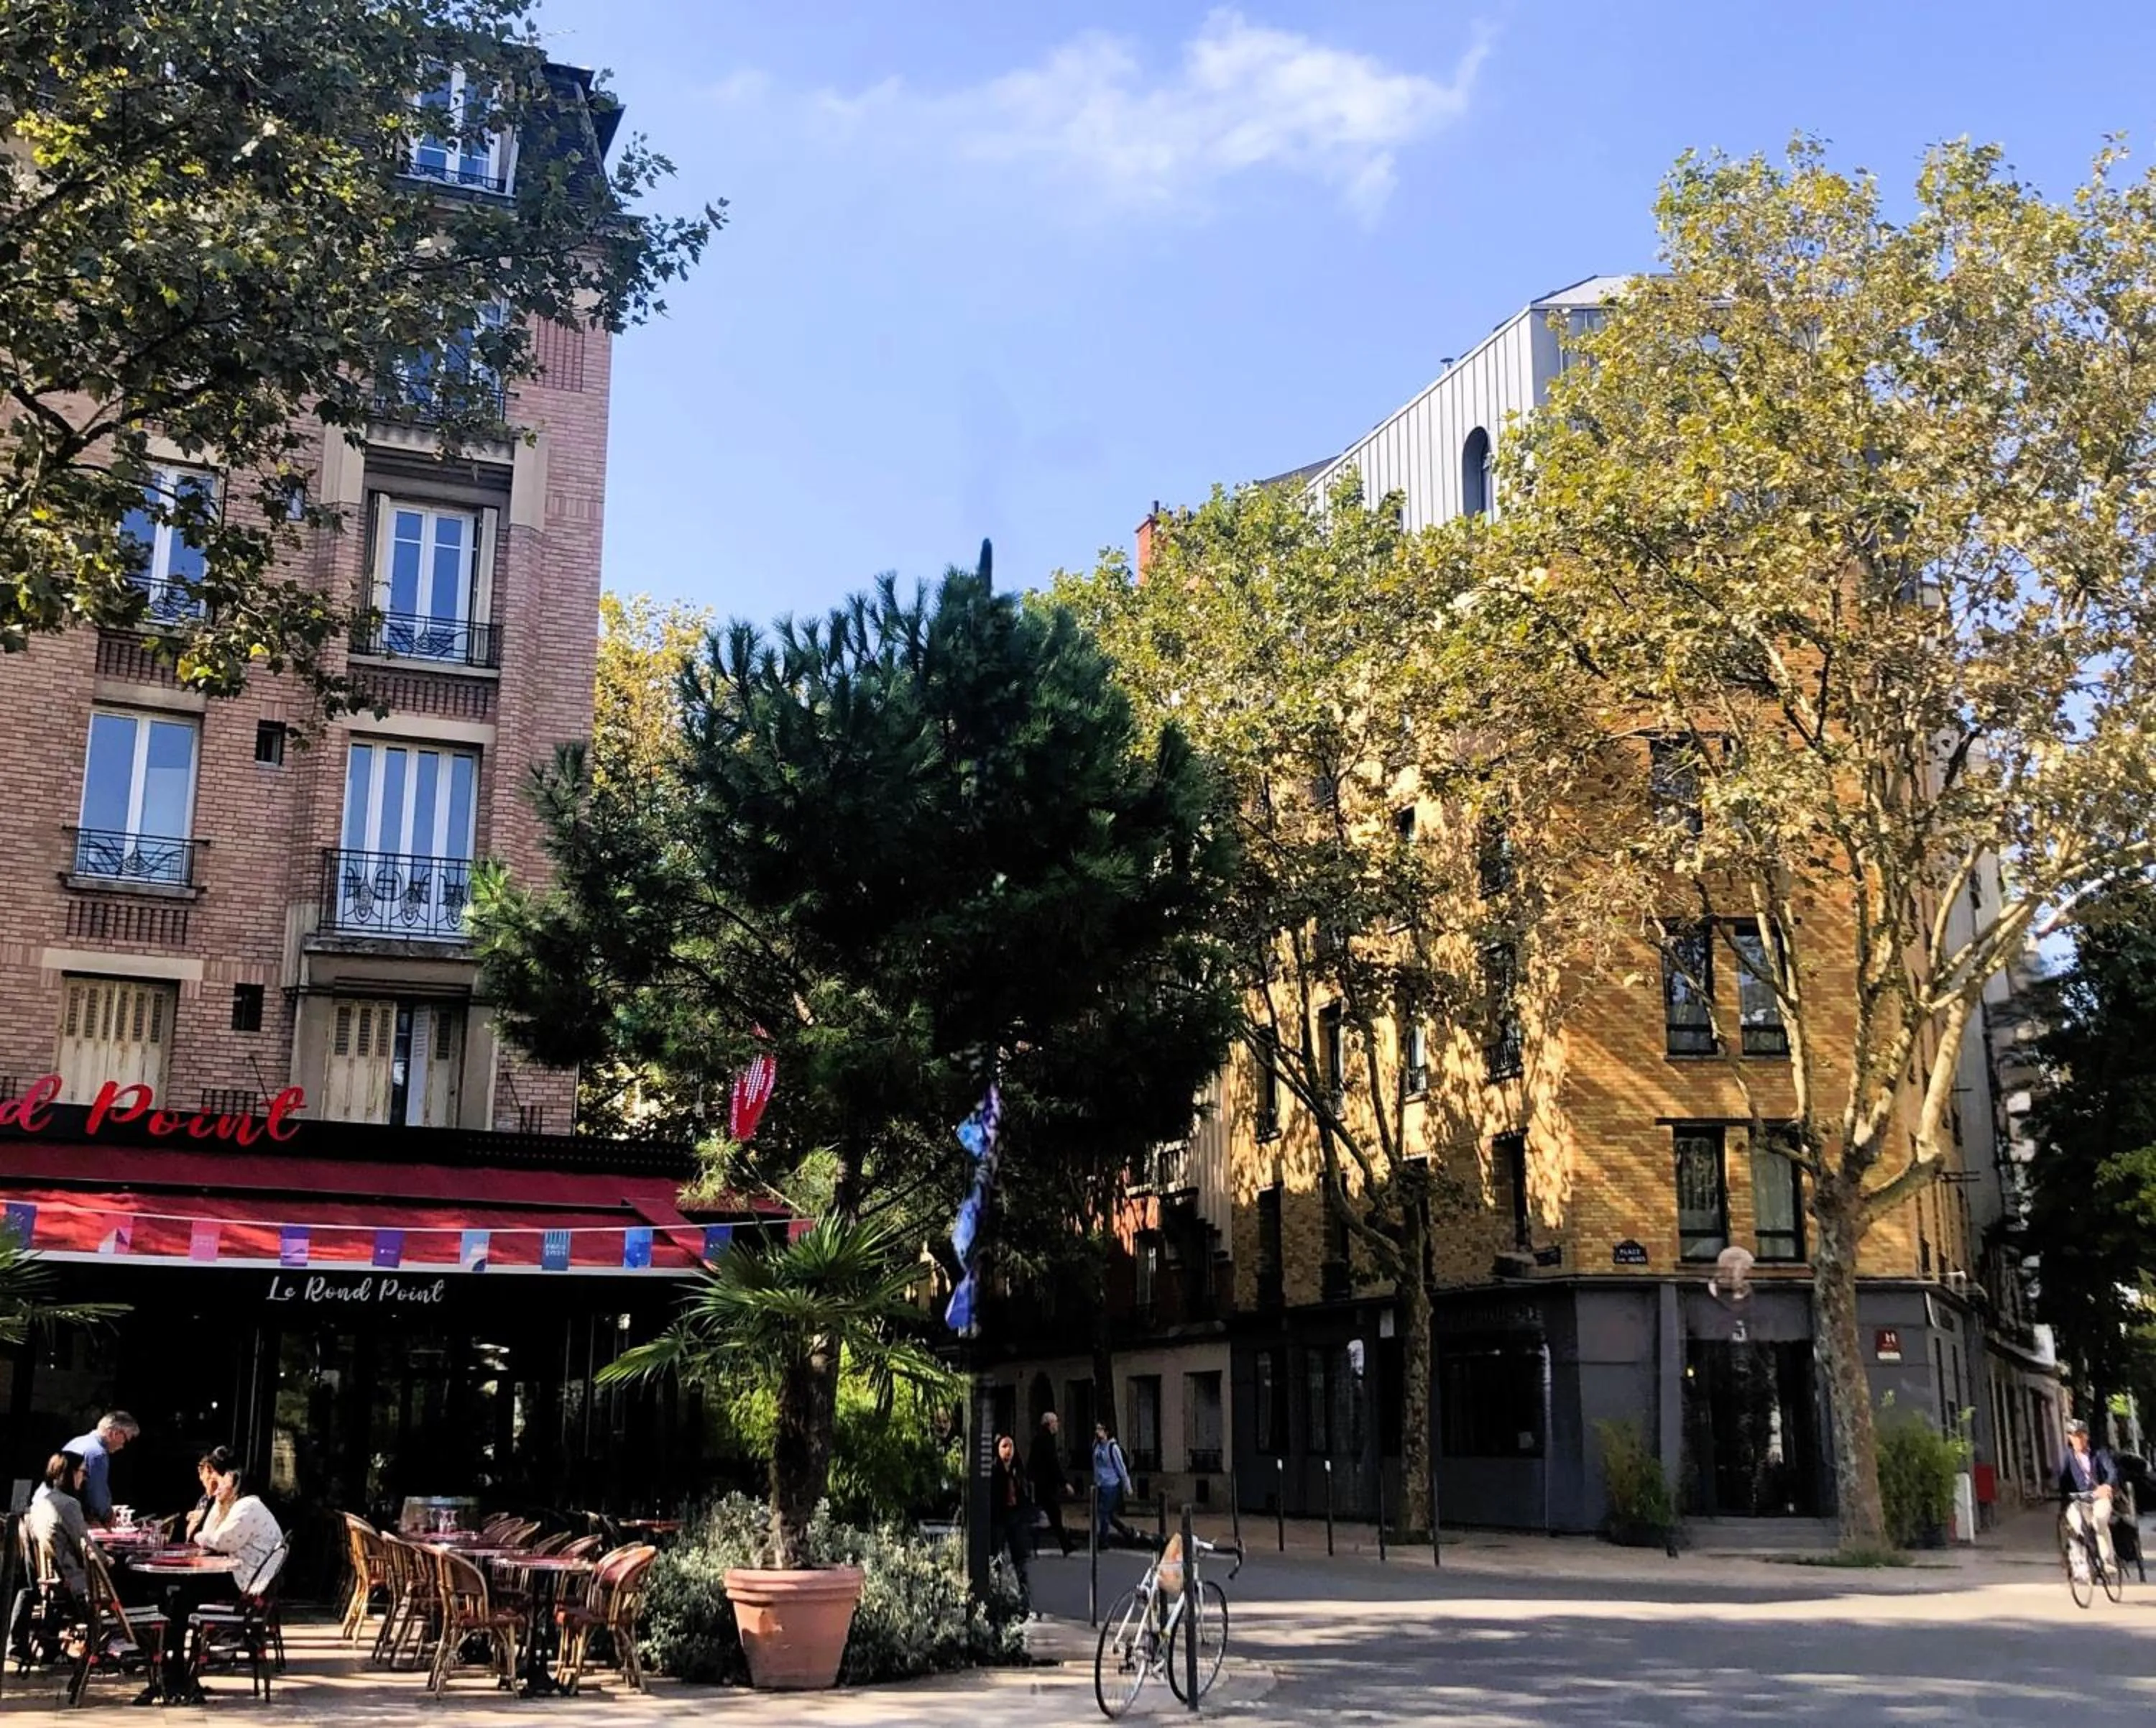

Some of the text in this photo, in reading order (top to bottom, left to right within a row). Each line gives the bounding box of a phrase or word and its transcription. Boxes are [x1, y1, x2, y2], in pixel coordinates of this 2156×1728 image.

[85, 1080, 308, 1147] Point
[266, 1276, 446, 1304] Le Rond Point
